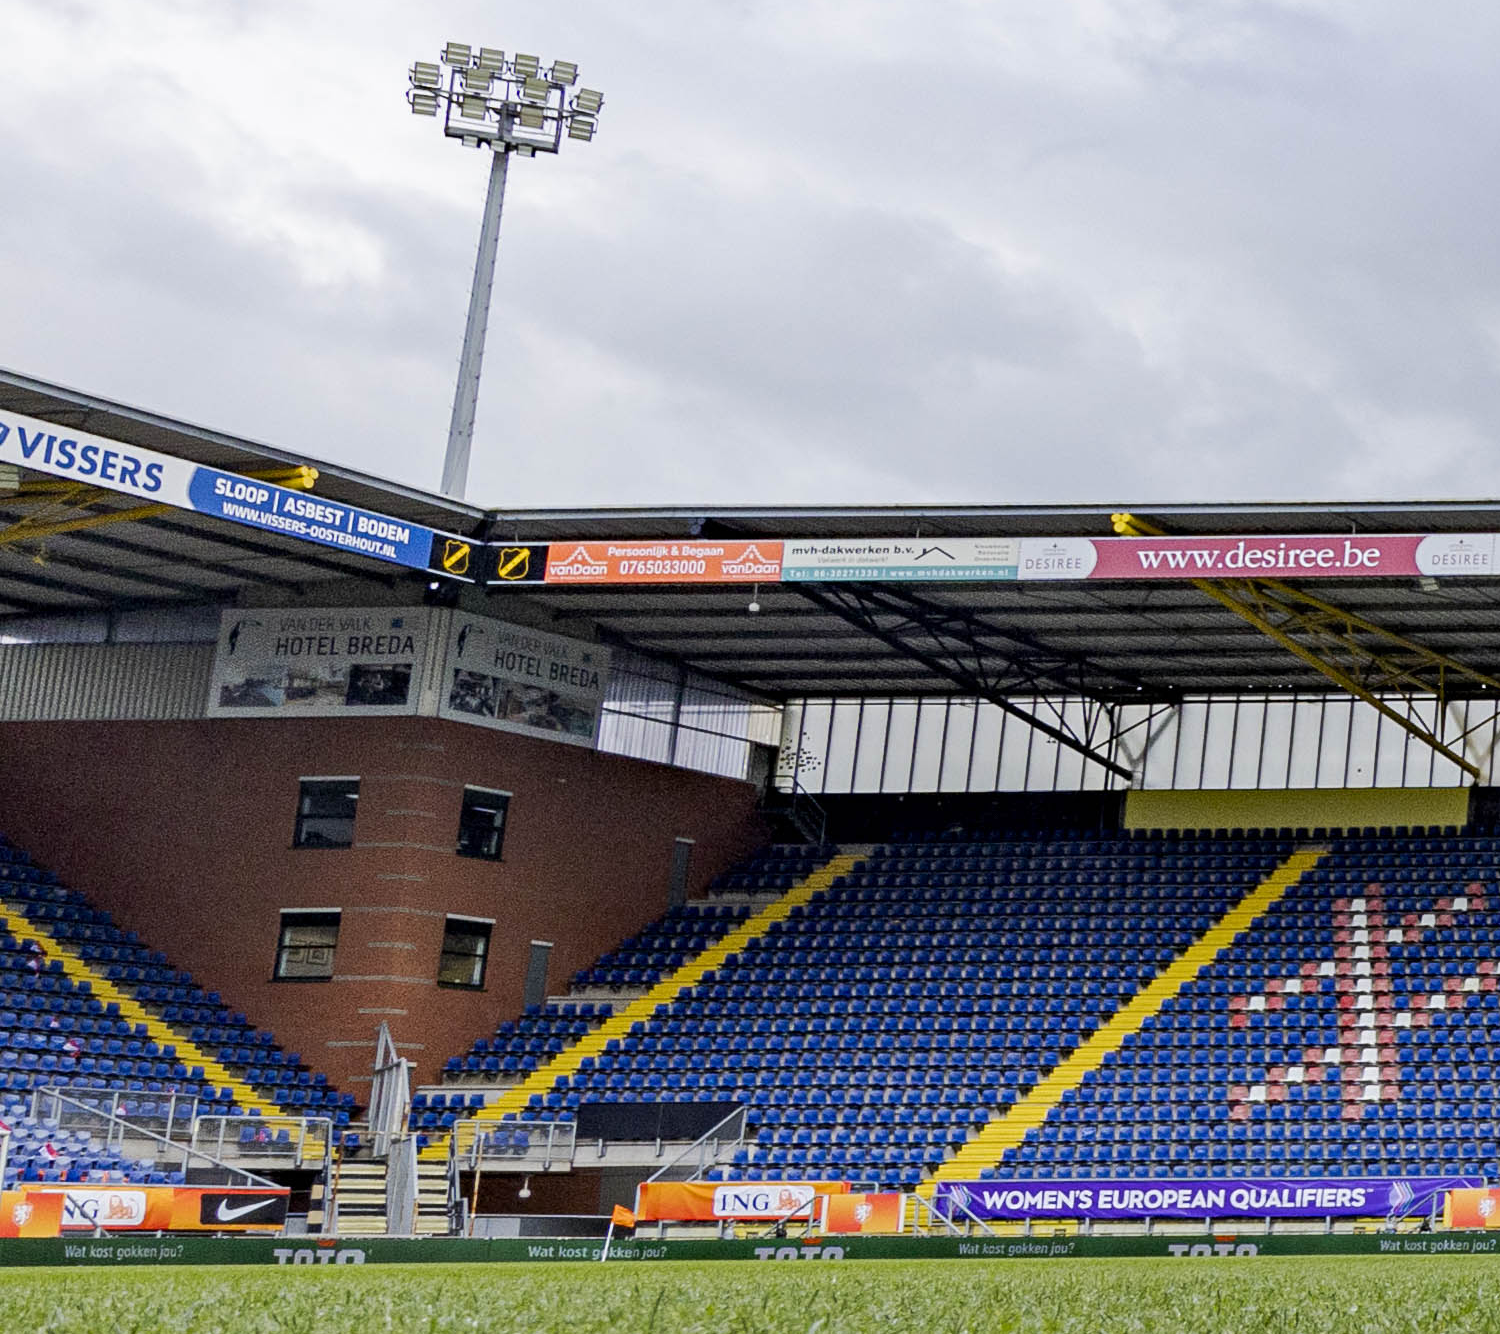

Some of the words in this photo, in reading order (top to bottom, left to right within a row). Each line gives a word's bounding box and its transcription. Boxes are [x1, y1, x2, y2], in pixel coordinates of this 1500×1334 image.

[17, 426, 164, 493] VISSERS
[214, 477, 269, 505] SLOOP
[283, 497, 344, 526] ASBEST
[357, 517, 411, 544] BODEM
[222, 501, 398, 558] WWW.VISSERS-OOSTERHOUT.NL
[608, 545, 669, 558] Persoonlijk
[671, 546, 679, 556] &
[682, 545, 724, 559] Begaan
[791, 544, 890, 556] mvh-dakwerken
[894, 545, 915, 555] b.v.
[1137, 540, 1380, 569] www.desiree.be
[550, 562, 608, 576] vanDaan
[620, 560, 706, 575] 0765033000
[722, 561, 780, 575] vanDaan
[275, 635, 339, 657] HOTEL
[346, 634, 415, 656] BREDA
[495, 648, 544, 680] HOTEL
[547, 658, 600, 690] BREDA
[64, 1196, 100, 1220] NG
[719, 1192, 770, 1212] ING
[983, 1189, 1094, 1210] WOMEN'S
[1099, 1188, 1226, 1210] EUROPEAN
[65, 1244, 86, 1258] Wat
[89, 1245, 113, 1258] kost
[116, 1245, 158, 1261] gokken
[158, 1244, 184, 1261] jou?
[958, 1244, 979, 1255] Wat
[983, 1243, 1005, 1255] kost
[1009, 1243, 1048, 1257] gokken
[1050, 1242, 1074, 1257] jou?
